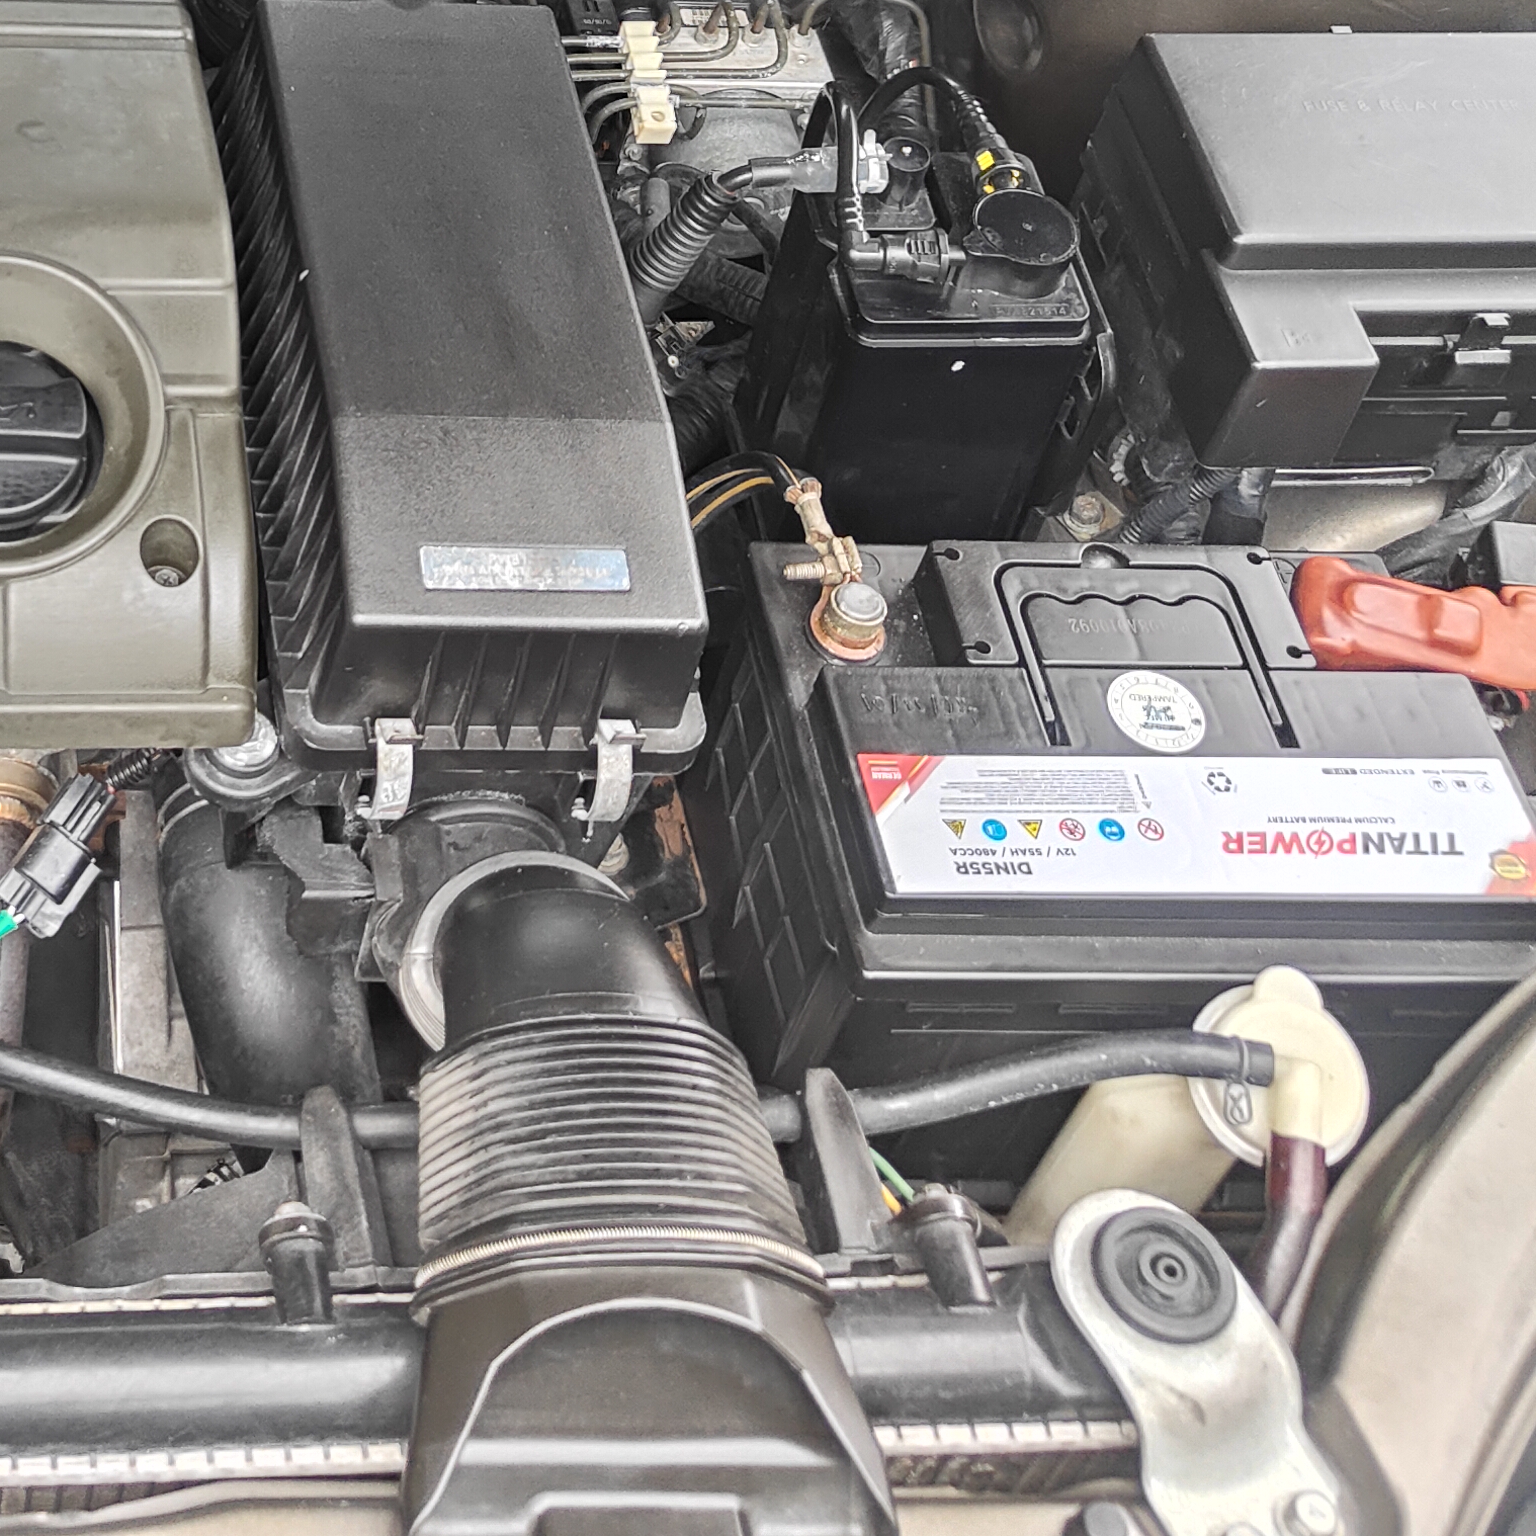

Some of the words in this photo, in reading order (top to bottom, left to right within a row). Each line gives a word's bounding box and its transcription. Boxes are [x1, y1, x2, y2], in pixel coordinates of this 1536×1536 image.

[1303, 99, 1350, 113] FUSE
[1357, 99, 1371, 112] &
[1378, 99, 1438, 113] RELAY
[1266, 815, 1307, 825] BATTERY
[1308, 816, 1352, 825] PREMIUM
[1354, 816, 1396, 825] CALCIUM
[1221, 828, 1464, 858] TITANPOWER
[948, 845, 999, 859] 480CCA
[1009, 846, 1044, 858] 55AH
[1055, 847, 1078, 858] 12V
[954, 859, 1034, 878] DIN55R
